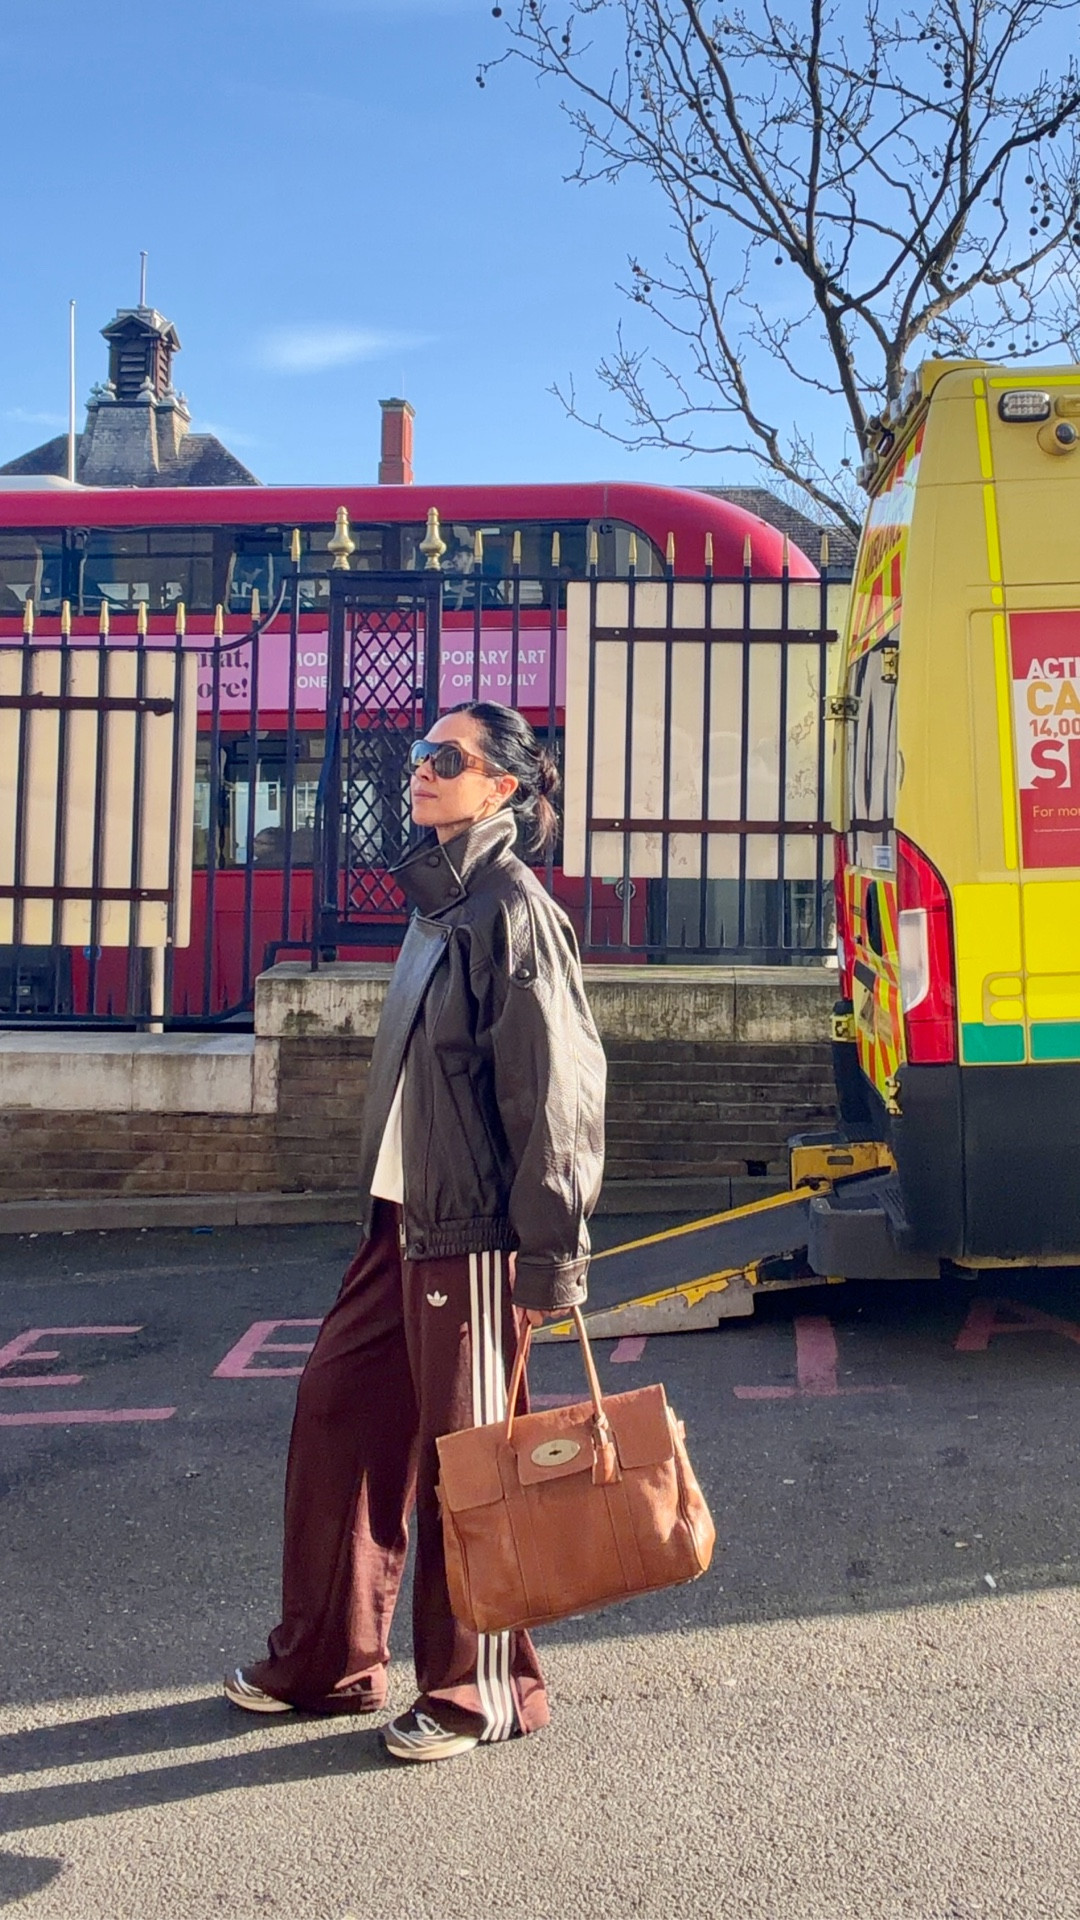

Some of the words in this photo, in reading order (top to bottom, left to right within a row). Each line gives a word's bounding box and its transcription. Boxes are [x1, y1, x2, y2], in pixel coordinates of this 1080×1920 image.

[517, 650, 546, 665] ART
[297, 675, 328, 689] ONE
[451, 674, 491, 687] OPN
[1033, 805, 1054, 817] For
